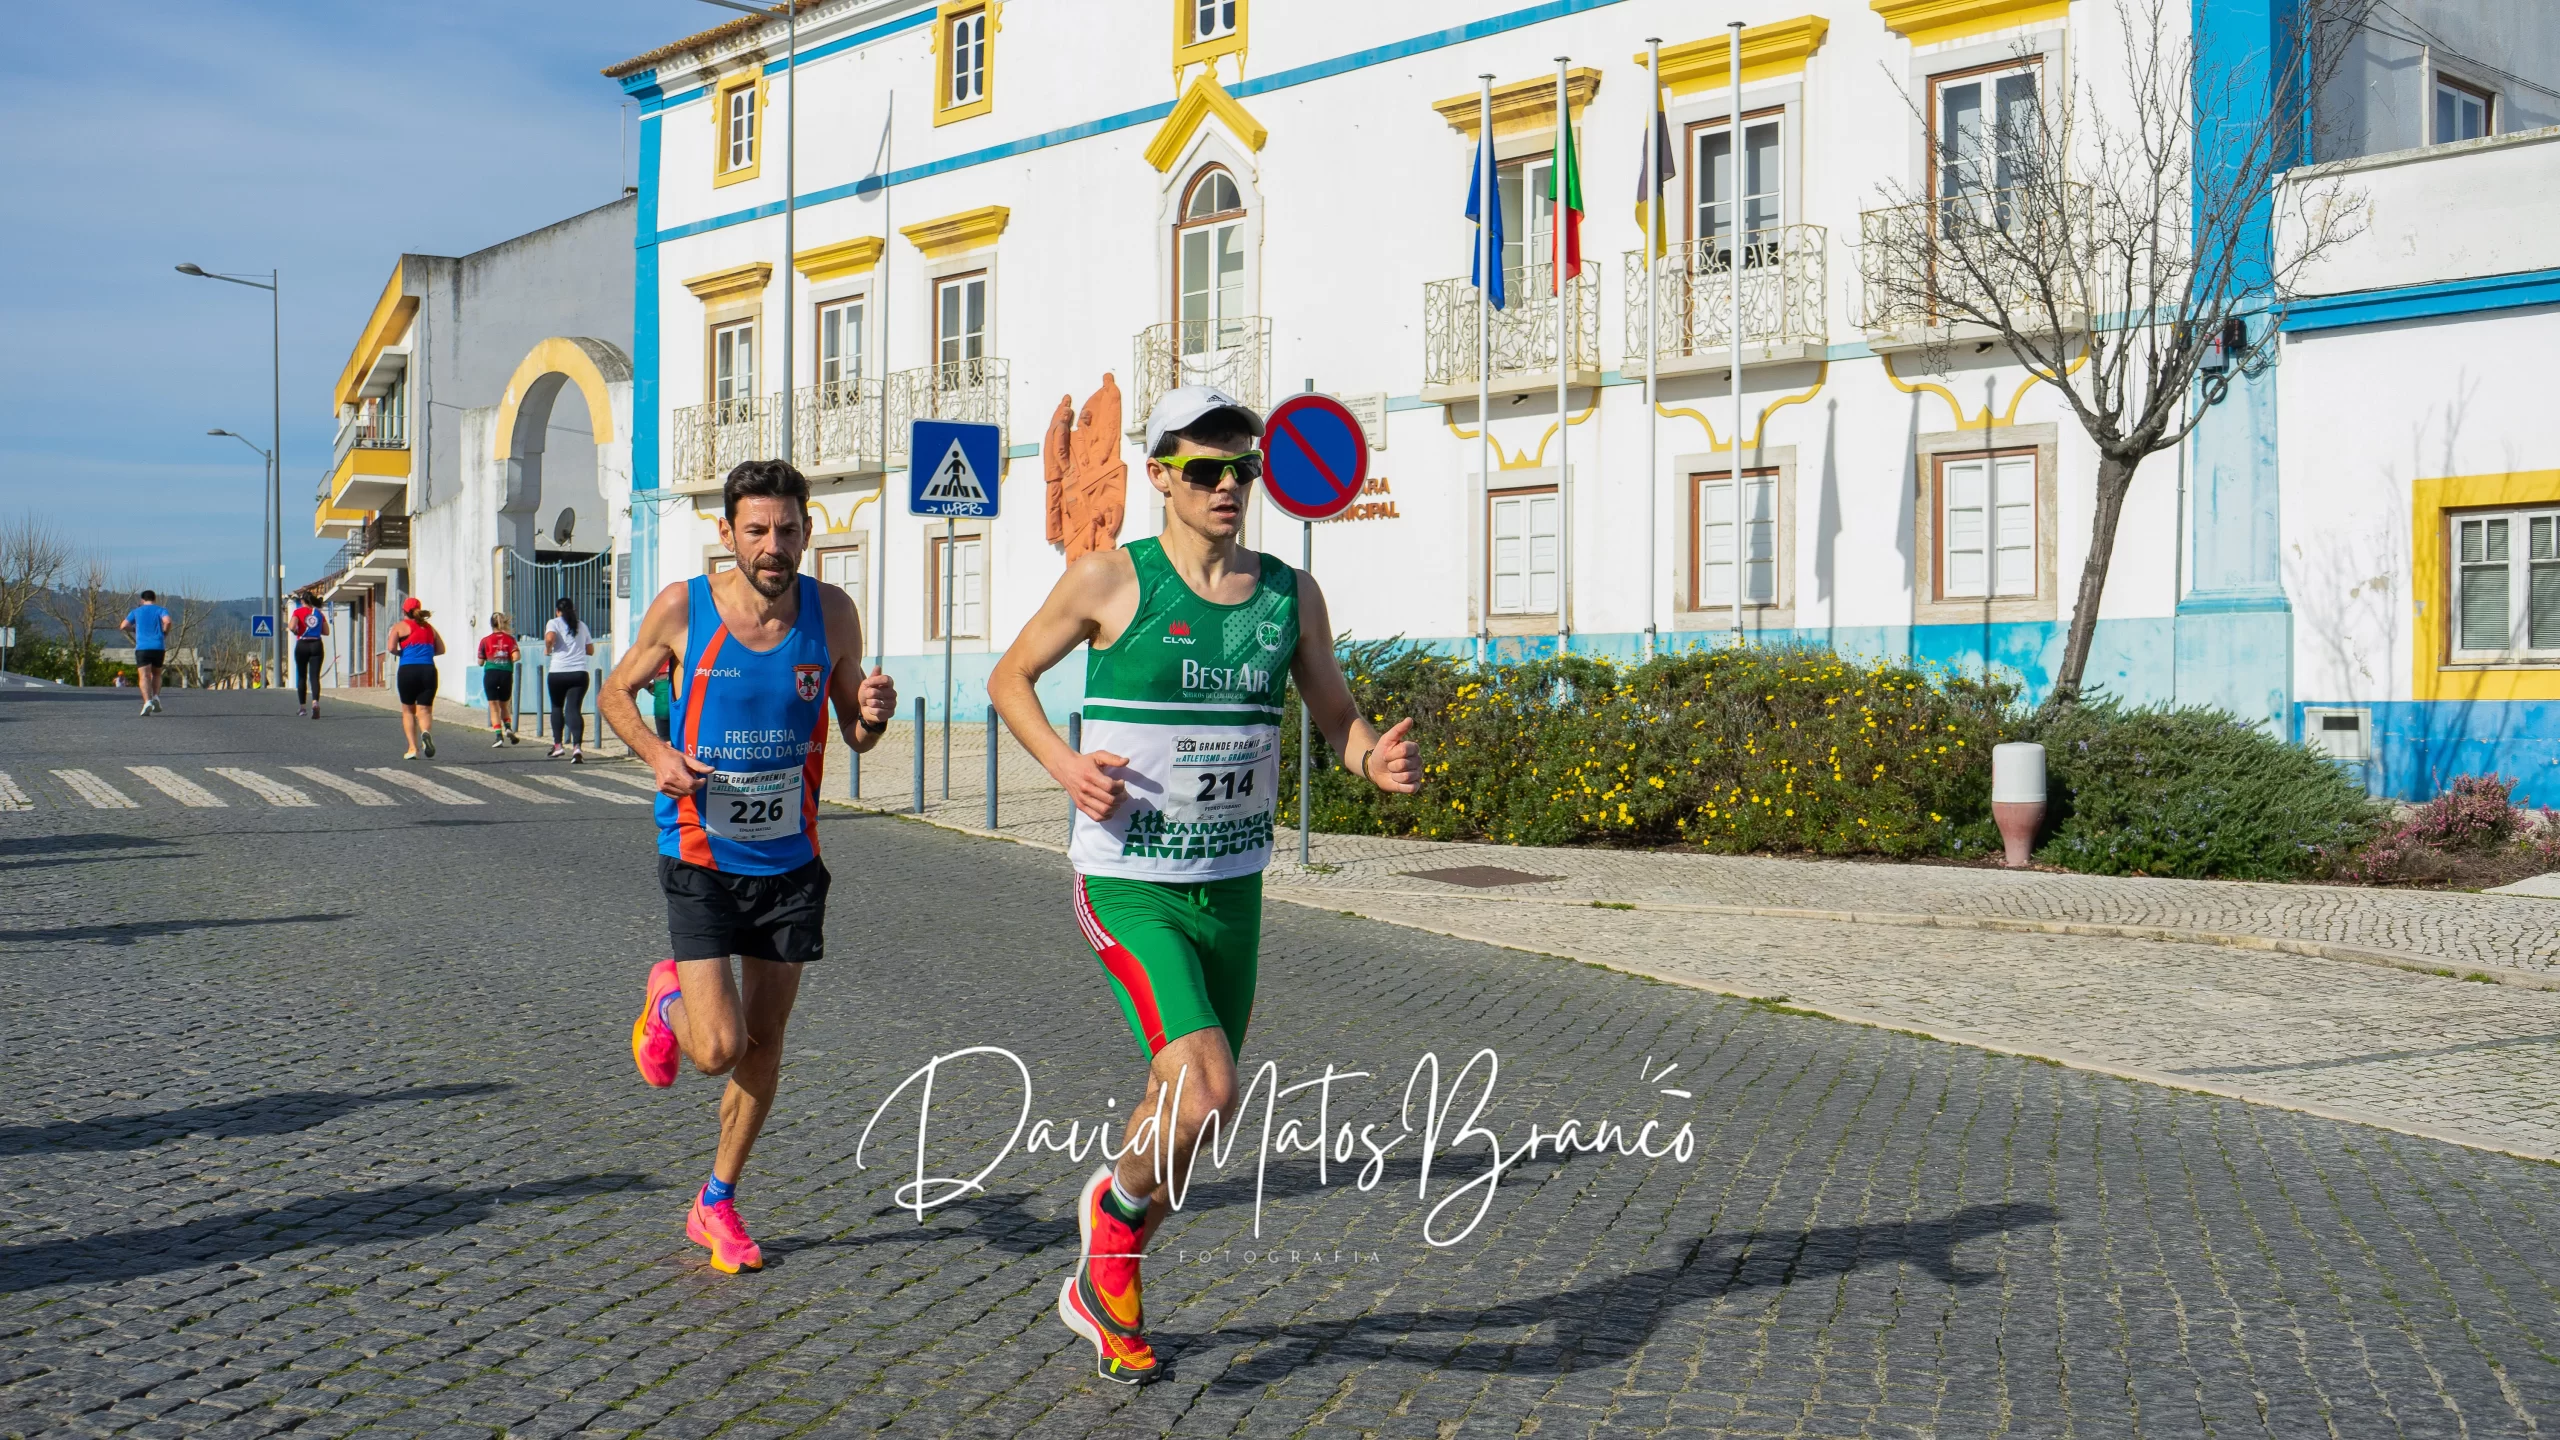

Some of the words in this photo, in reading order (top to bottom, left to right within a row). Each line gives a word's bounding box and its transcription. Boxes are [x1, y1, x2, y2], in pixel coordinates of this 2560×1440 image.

[1162, 636, 1197, 645] CLAW
[725, 729, 796, 744] FREGUESIA
[687, 744, 696, 757] S.
[698, 745, 772, 760] FRANCISCO
[776, 745, 792, 758] DA
[795, 741, 823, 756] SERRA
[1199, 741, 1231, 751] GRANDE
[1181, 754, 1220, 763] ATLETISMO
[731, 776, 759, 784] GRANDE
[1196, 769, 1254, 802] 214
[729, 797, 783, 824] 226
